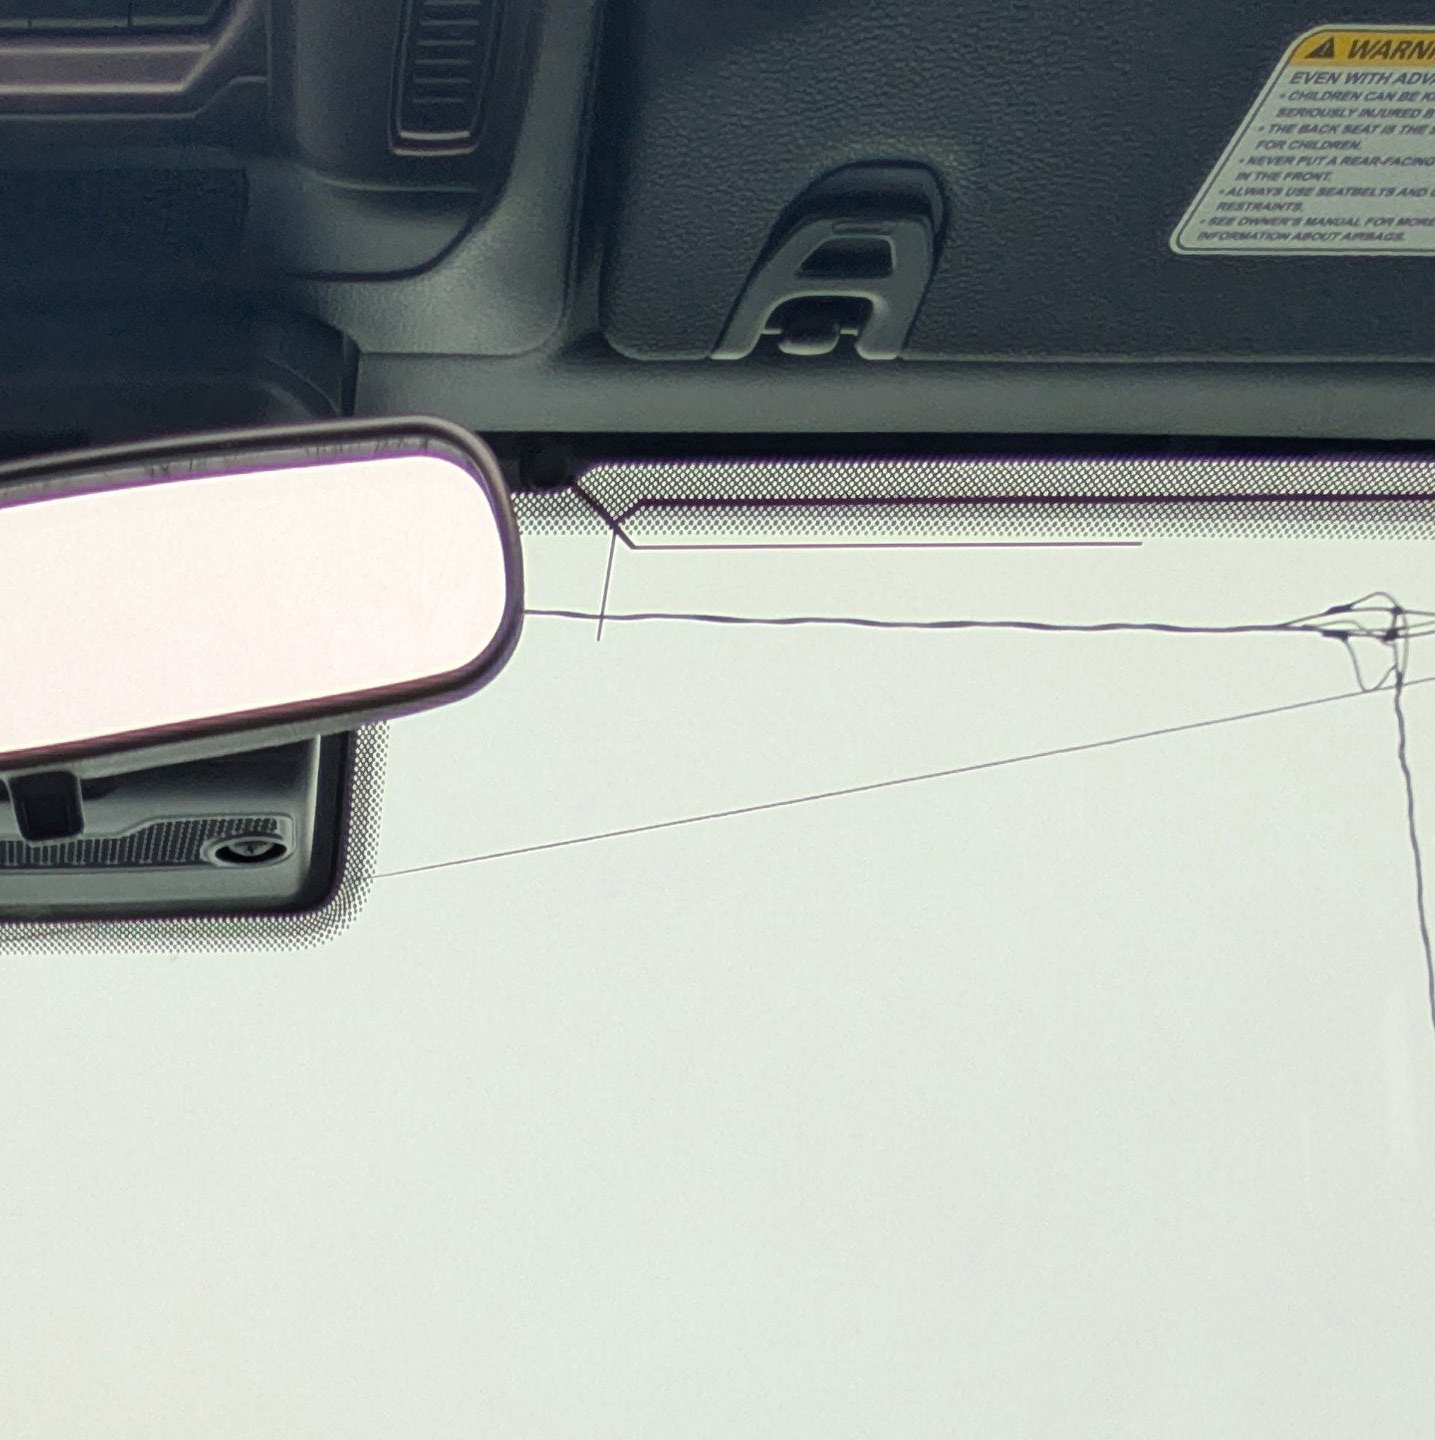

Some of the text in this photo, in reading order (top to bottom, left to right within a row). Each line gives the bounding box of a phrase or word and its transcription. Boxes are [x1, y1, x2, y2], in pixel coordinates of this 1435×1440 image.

[1289, 71, 1344, 86] EVEN
[1344, 71, 1393, 86] WITH
[1287, 91, 1364, 103] CHILDREN
[1364, 91, 1398, 103] CAN
[1398, 91, 1419, 103] BE
